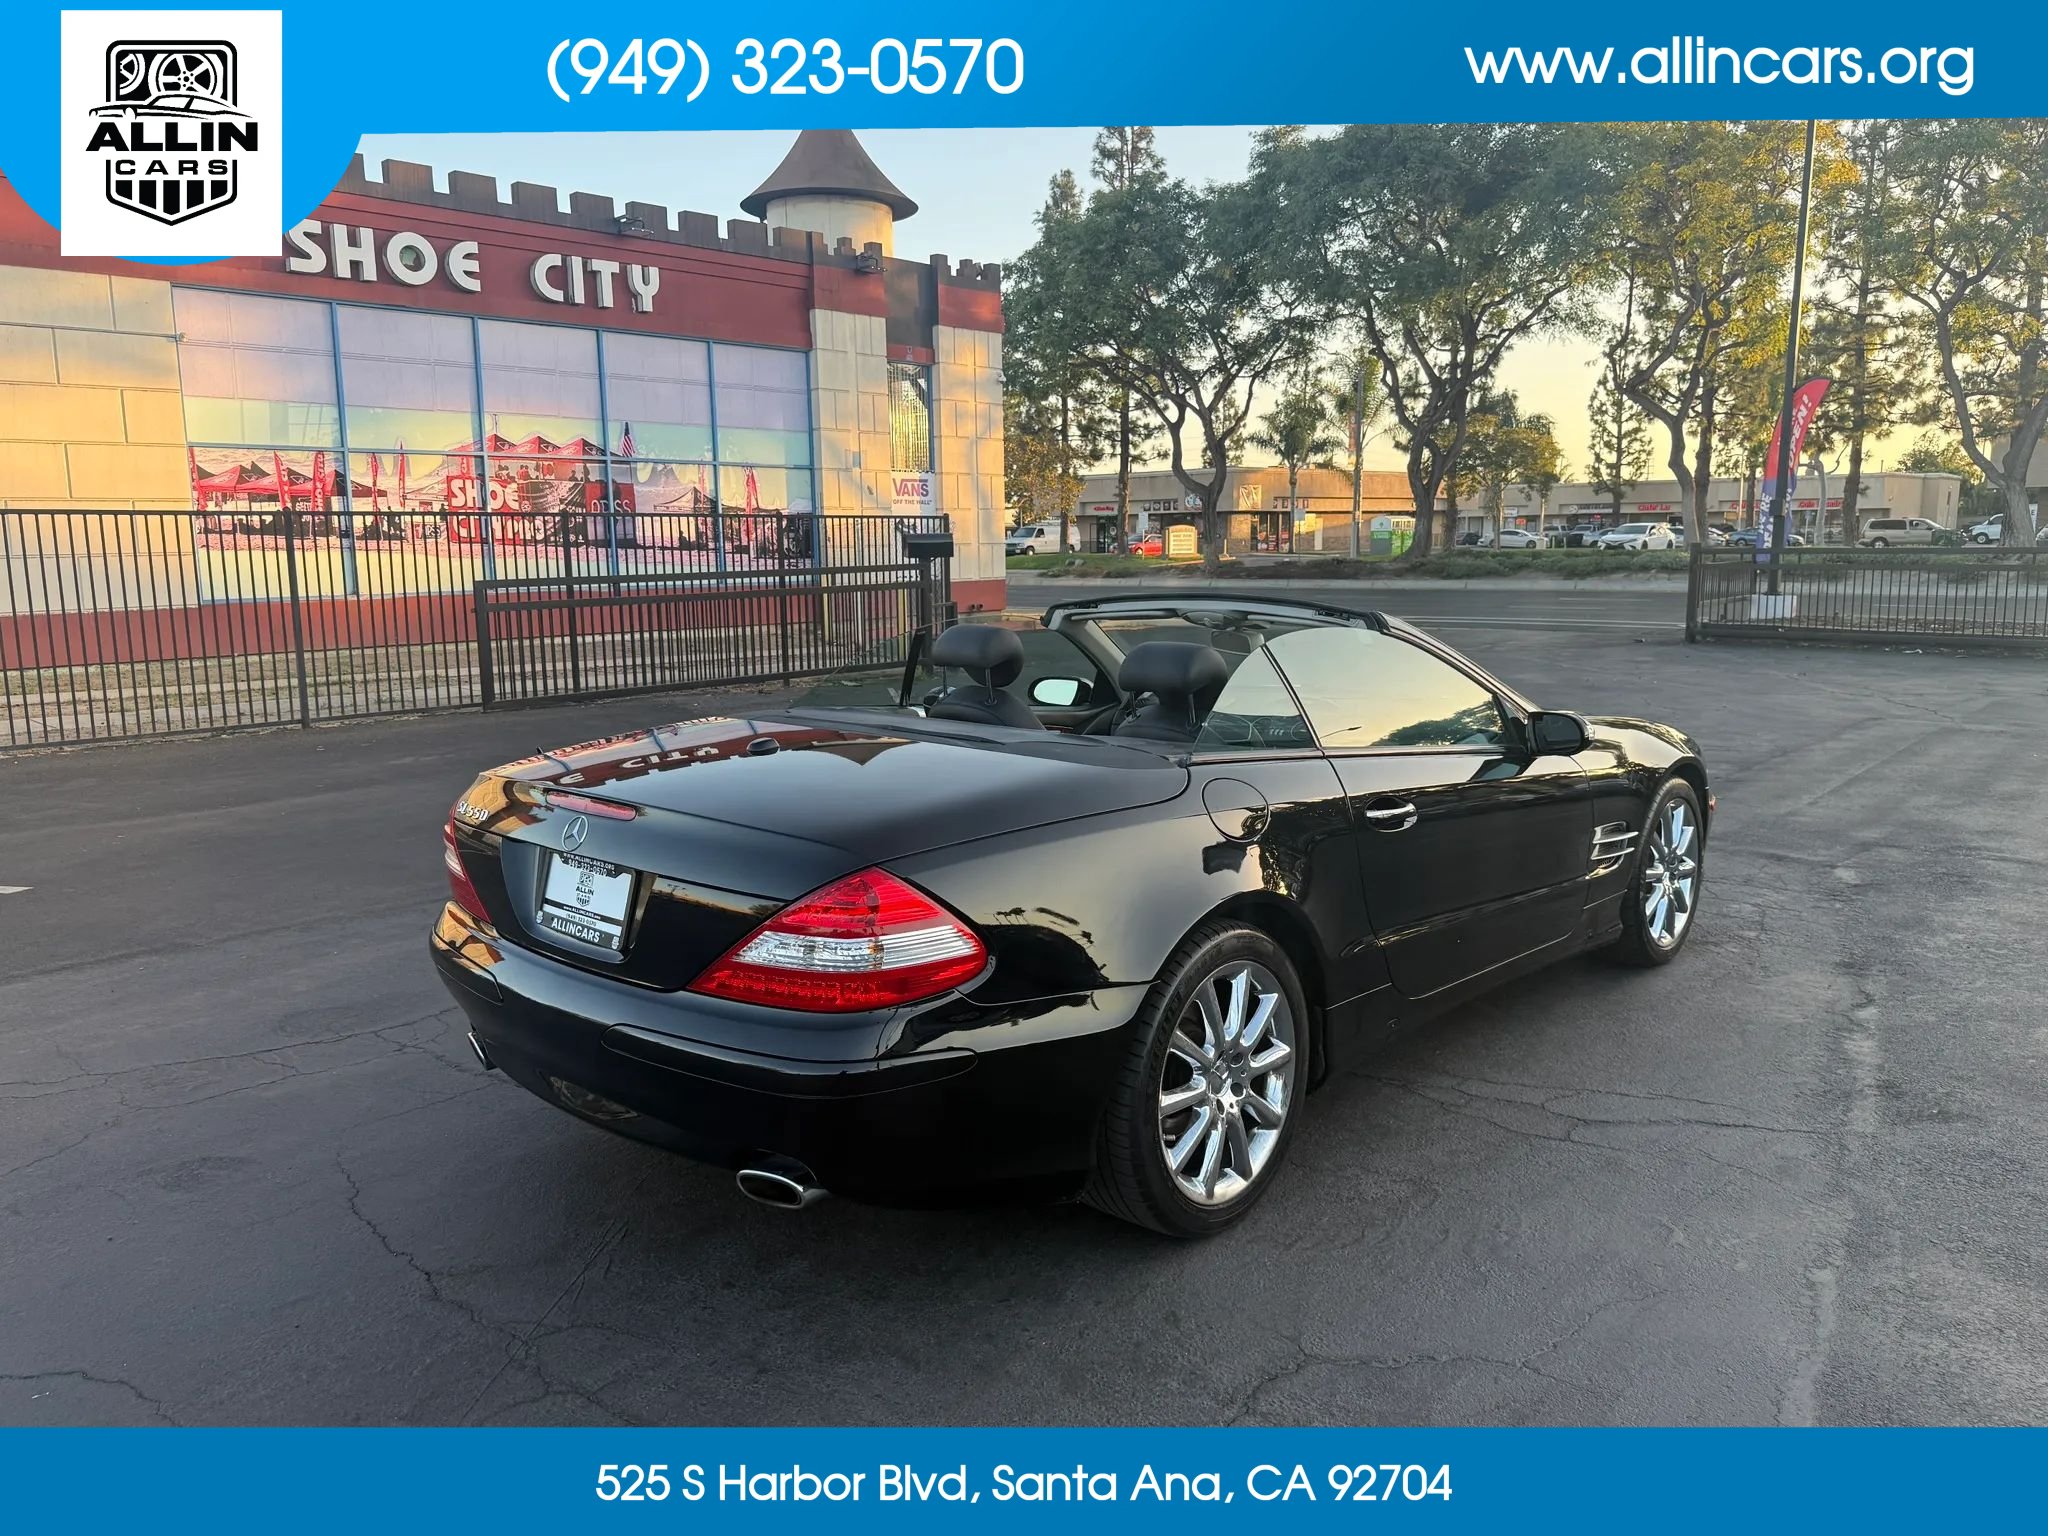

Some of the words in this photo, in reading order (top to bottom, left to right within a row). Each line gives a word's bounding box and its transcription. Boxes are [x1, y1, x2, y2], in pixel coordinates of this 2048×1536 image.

[285, 218, 481, 292] SHOE
[530, 253, 660, 313] CITY
[450, 479, 519, 511] SHOE
[892, 477, 929, 498] VANS
[575, 885, 595, 896] ALLIN
[551, 917, 601, 943] ALLINCARS
